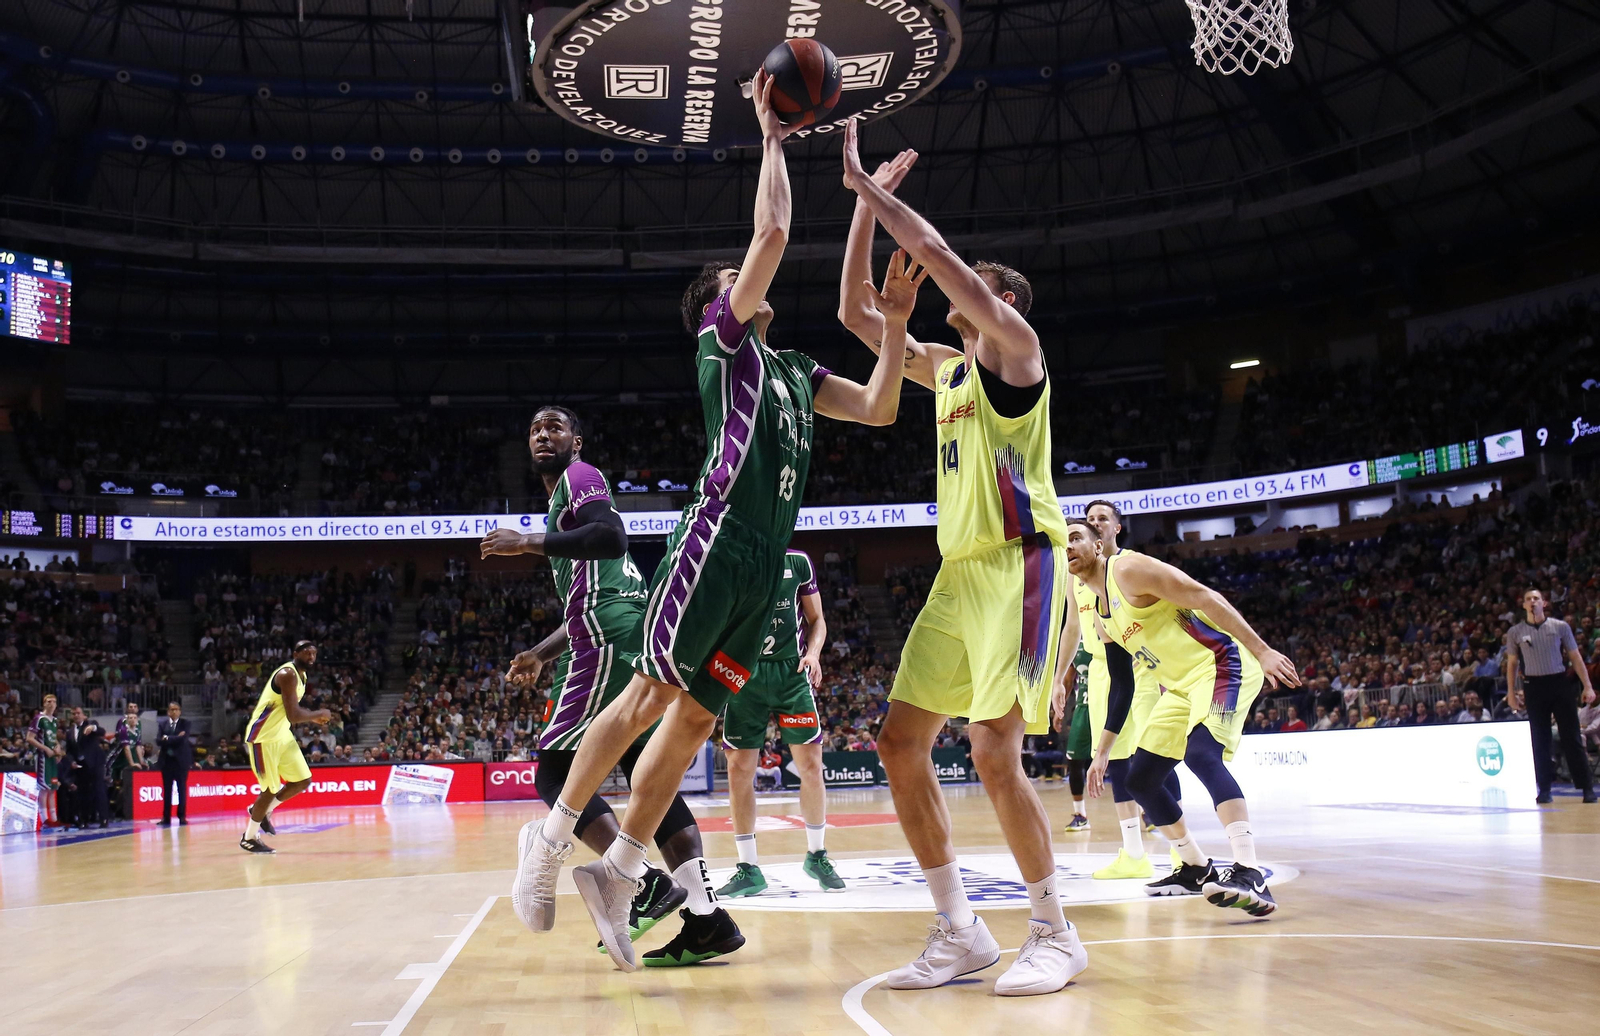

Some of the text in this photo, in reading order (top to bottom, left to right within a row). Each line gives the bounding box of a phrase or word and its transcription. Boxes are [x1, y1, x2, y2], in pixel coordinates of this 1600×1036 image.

[686, 66, 719, 85] LA
[682, 90, 715, 143] RESERVA
[1537, 428, 1548, 446] 9
[940, 439, 959, 477] 14
[1138, 490, 1200, 510] directo
[1206, 489, 1227, 503] en
[1233, 483, 1250, 500] el
[1254, 478, 1296, 497] 93.4
[1301, 472, 1326, 491] FM
[819, 510, 834, 525] el
[838, 509, 878, 525] 93.4
[882, 508, 905, 523] FM
[155, 519, 498, 537] Ahora estamos en directo en el 93.4 FM
[1134, 645, 1161, 670] 30
[783, 715, 814, 724] worten
[824, 767, 874, 782] Unicaja
[935, 762, 966, 778] icaja
[140, 786, 163, 803] SUR
[353, 780, 376, 791] EN
